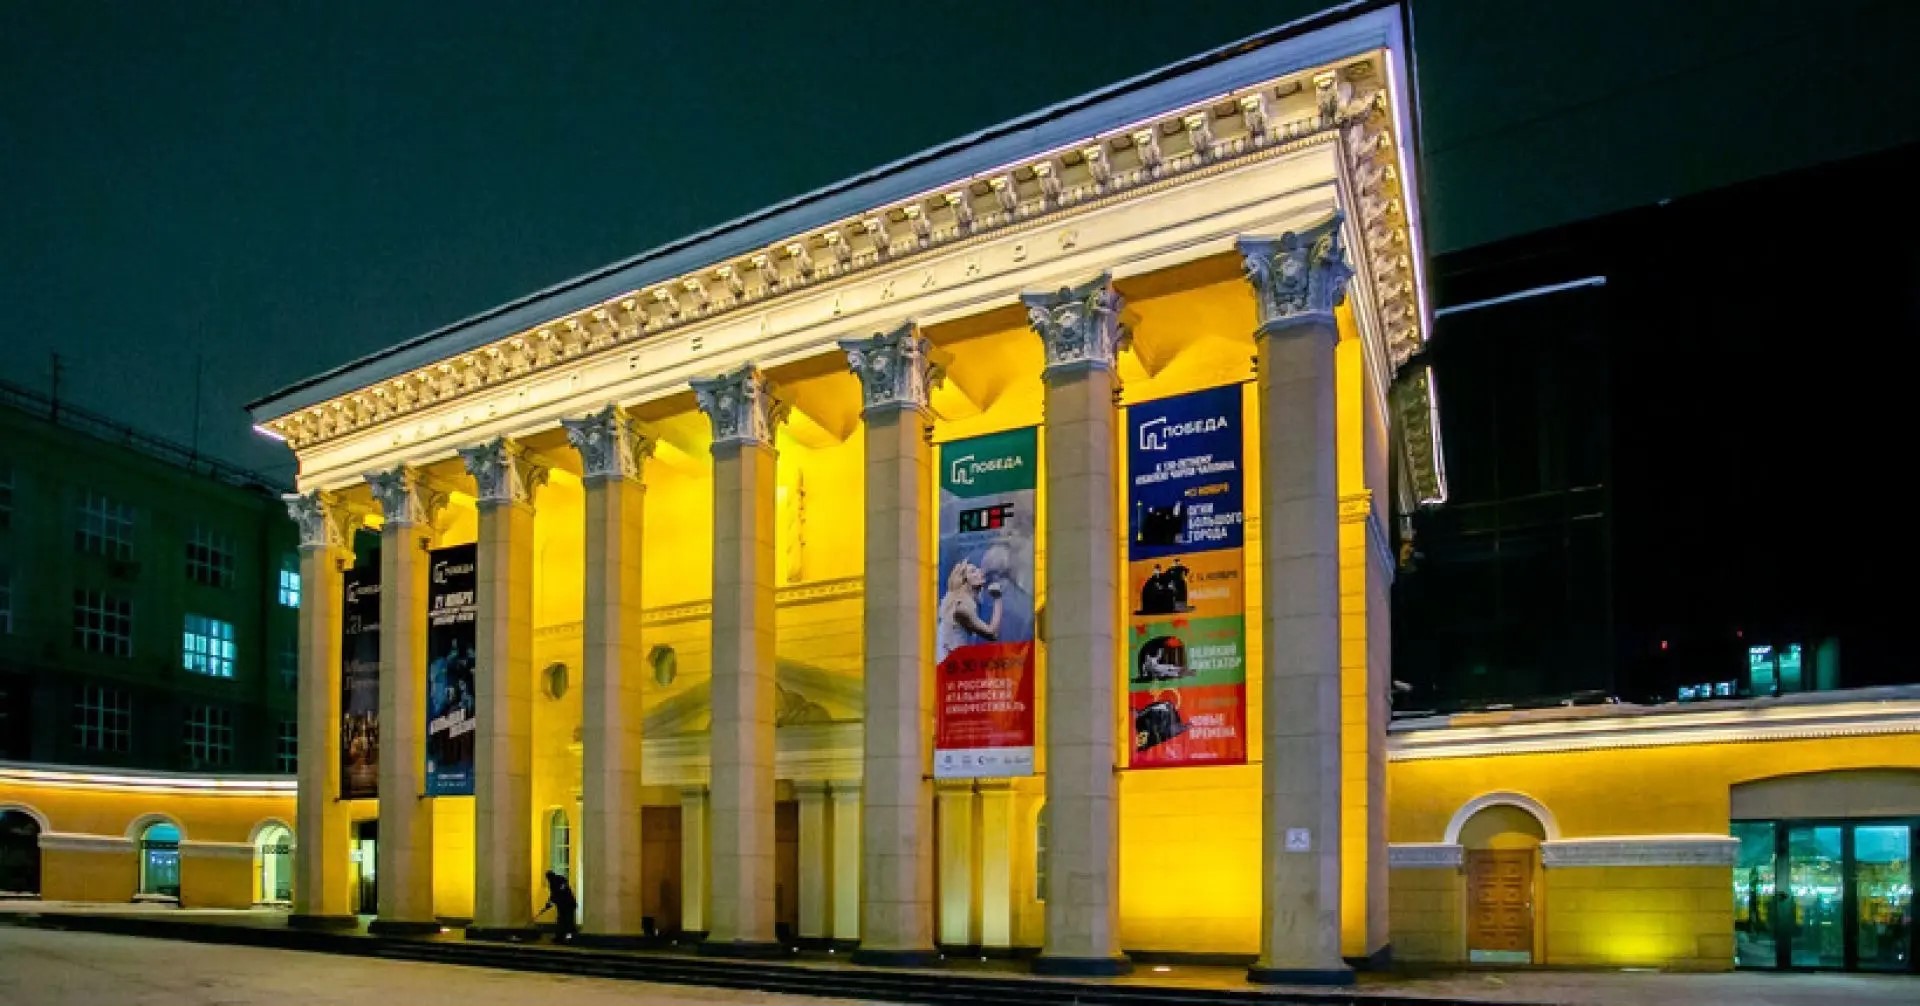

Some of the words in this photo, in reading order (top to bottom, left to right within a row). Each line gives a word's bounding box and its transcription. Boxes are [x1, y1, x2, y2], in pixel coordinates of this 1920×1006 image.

[1163, 415, 1228, 438] ПОБЕДА
[971, 455, 1024, 475] ПОБЕДА
[1187, 502, 1214, 516] ОГНИ
[1187, 510, 1242, 530] БОЛЬШОГО
[1187, 526, 1228, 543] ГОРОДА
[1188, 642, 1237, 658] ВЕЛИКИЙ
[1188, 656, 1242, 671] ДИКТАТОР
[946, 690, 1012, 702] ИТАЛЬЯНСКИЙ
[946, 701, 1026, 714] КИНОФЕСТИВАЛЬ
[1189, 713, 1225, 726] НОВЫЕ
[1189, 726, 1237, 740] ВРЕМЕНА
